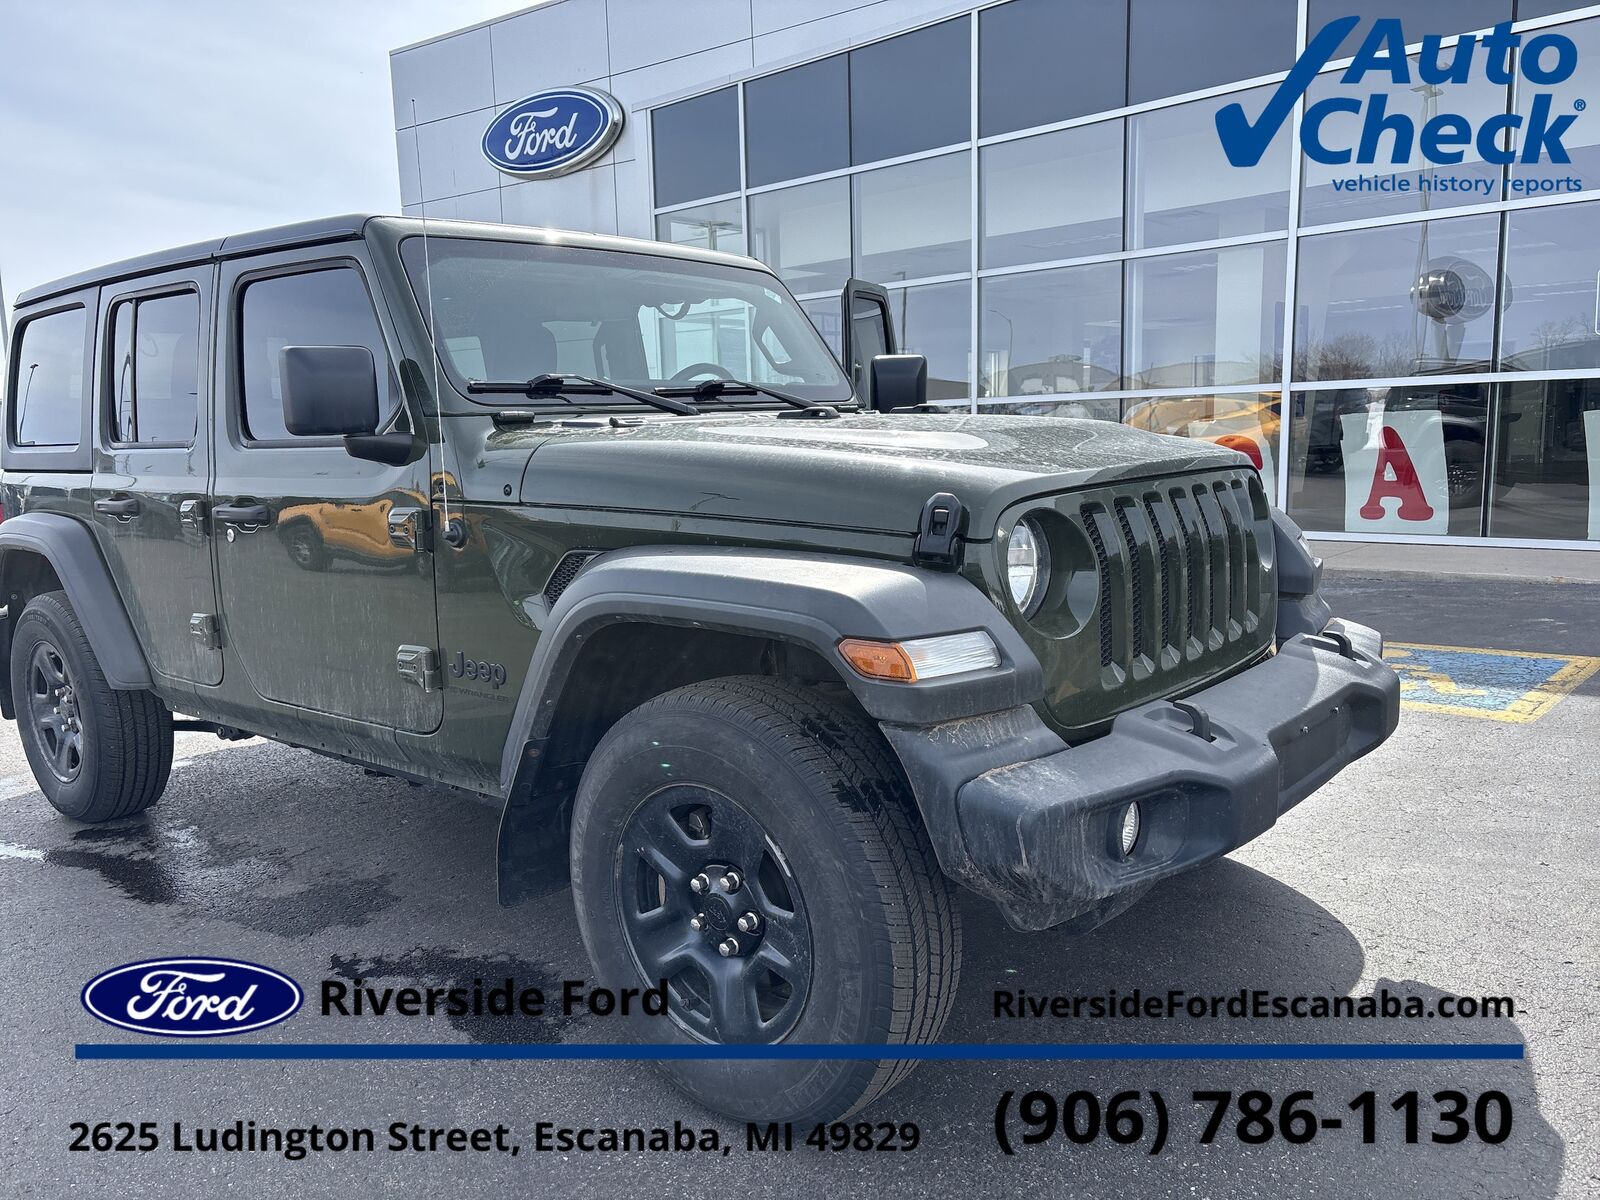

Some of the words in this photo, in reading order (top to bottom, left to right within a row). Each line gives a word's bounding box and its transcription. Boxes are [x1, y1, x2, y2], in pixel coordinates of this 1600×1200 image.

[504, 106, 579, 161] Ford
[1359, 425, 1434, 522] A
[448, 651, 507, 690] Jeep
